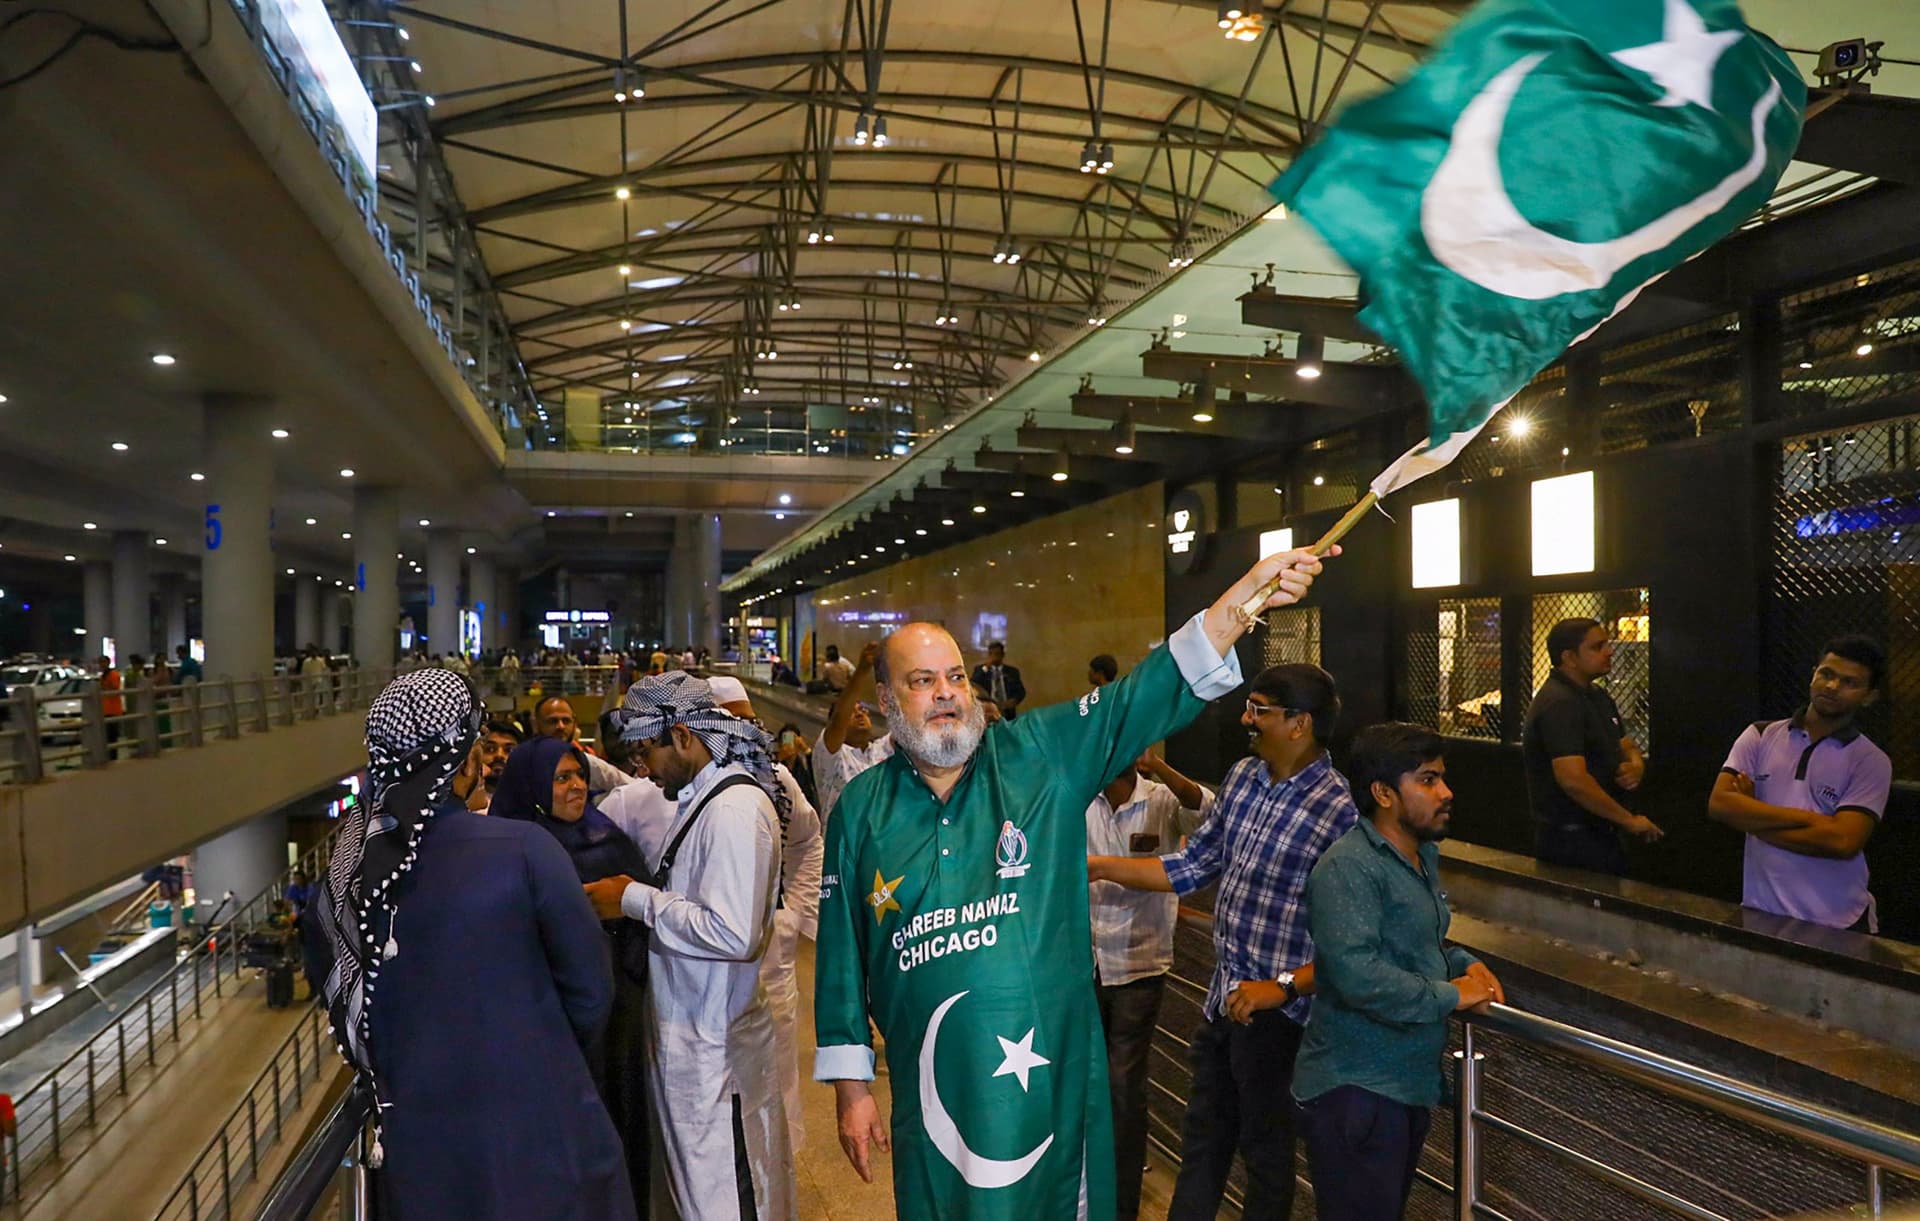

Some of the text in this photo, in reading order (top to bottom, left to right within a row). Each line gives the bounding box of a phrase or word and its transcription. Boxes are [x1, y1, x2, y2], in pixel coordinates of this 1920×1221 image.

[206, 504, 222, 550] 5
[892, 892, 1020, 950] GHAREEB NAWAZ
[899, 924, 998, 972] CHICAGO
